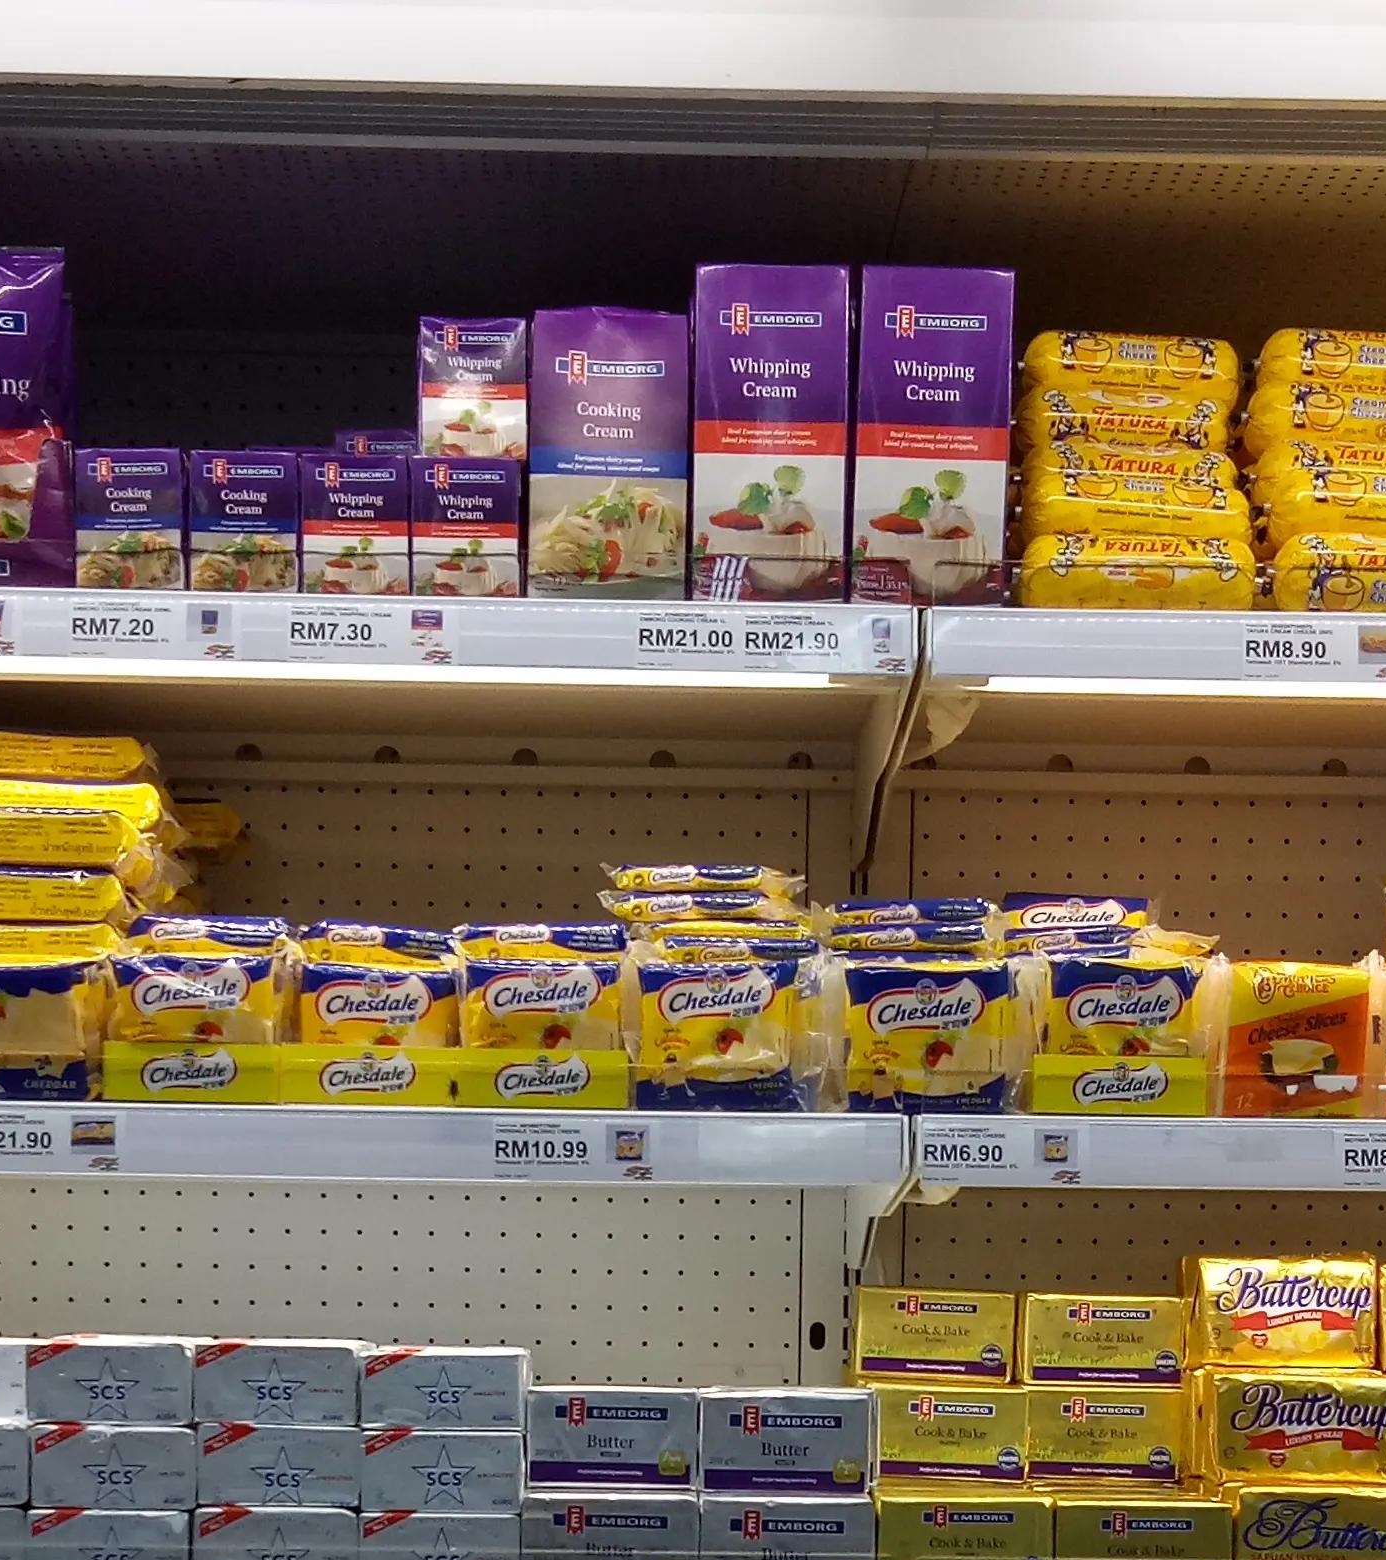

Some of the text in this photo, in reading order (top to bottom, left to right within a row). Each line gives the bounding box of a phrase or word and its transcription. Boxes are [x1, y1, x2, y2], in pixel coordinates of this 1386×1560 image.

[591, 362, 658, 376] EMBORG
[893, 359, 975, 383] Whipping
[905, 384, 960, 403] Cream
[1097, 452, 1178, 476] TATURA
[105, 488, 152, 503] Cooking
[328, 492, 383, 508] Whipping
[111, 501, 147, 513] Cream
[72, 617, 154, 637] RM7.20
[290, 621, 373, 642] RM7.30
[637, 627, 733, 648] RM21.00
[744, 629, 840, 654] RM21.90
[1245, 638, 1327, 661] RM8.90
[494, 982, 586, 1008] Chesdale
[325, 995, 420, 1020] Chesdale
[1247, 1022, 1300, 1045] Cheese
[1081, 1077, 1159, 1098] Chesdale
[495, 1139, 588, 1160] RM10.99
[924, 1144, 1003, 1165] RM6.90
[90, 1382, 125, 1399] SCS
[592, 1407, 662, 1420] EMBORG
[914, 1425, 987, 1440] Cook & Bake
[761, 1441, 808, 1458] Butter
